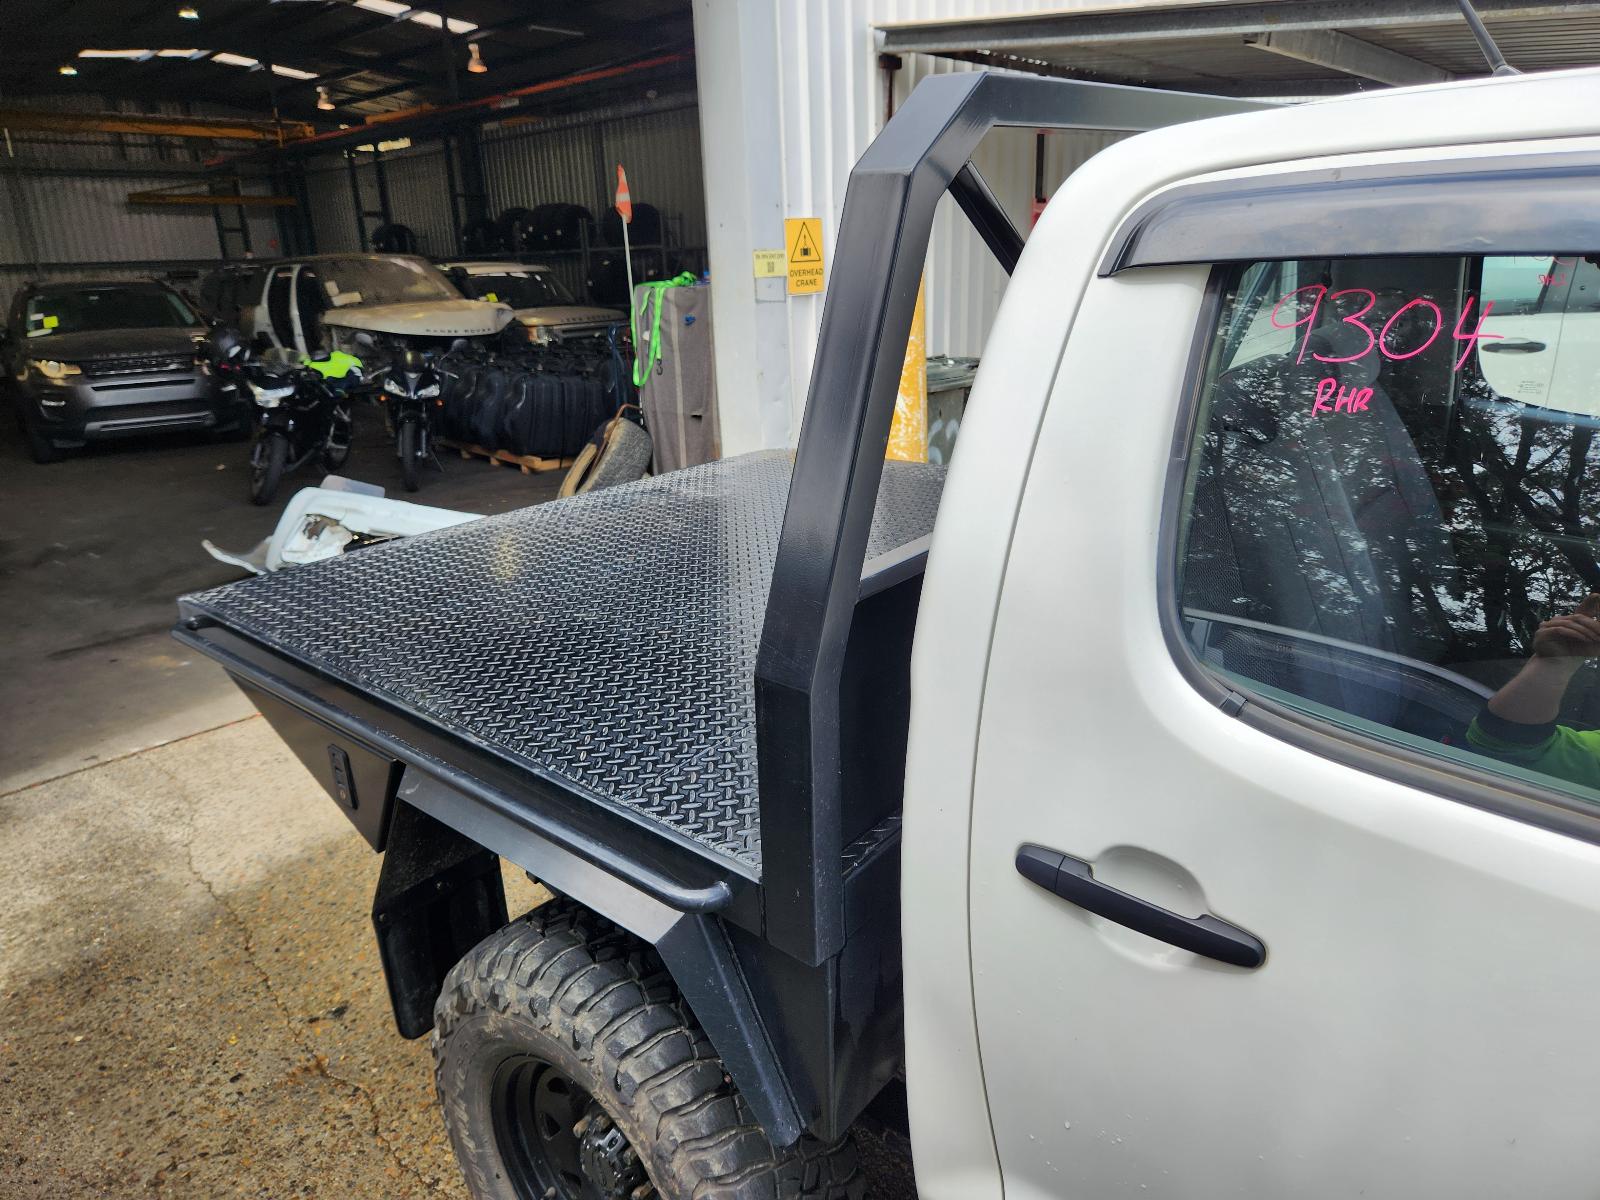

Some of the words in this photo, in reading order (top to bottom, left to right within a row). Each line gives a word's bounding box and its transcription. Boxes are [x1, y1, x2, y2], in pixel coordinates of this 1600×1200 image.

[789, 268, 823, 278] OVERHEAD
[796, 279, 817, 287] CRANE
[1270, 283, 1504, 372] 9304
[1311, 377, 1375, 418] RHR
